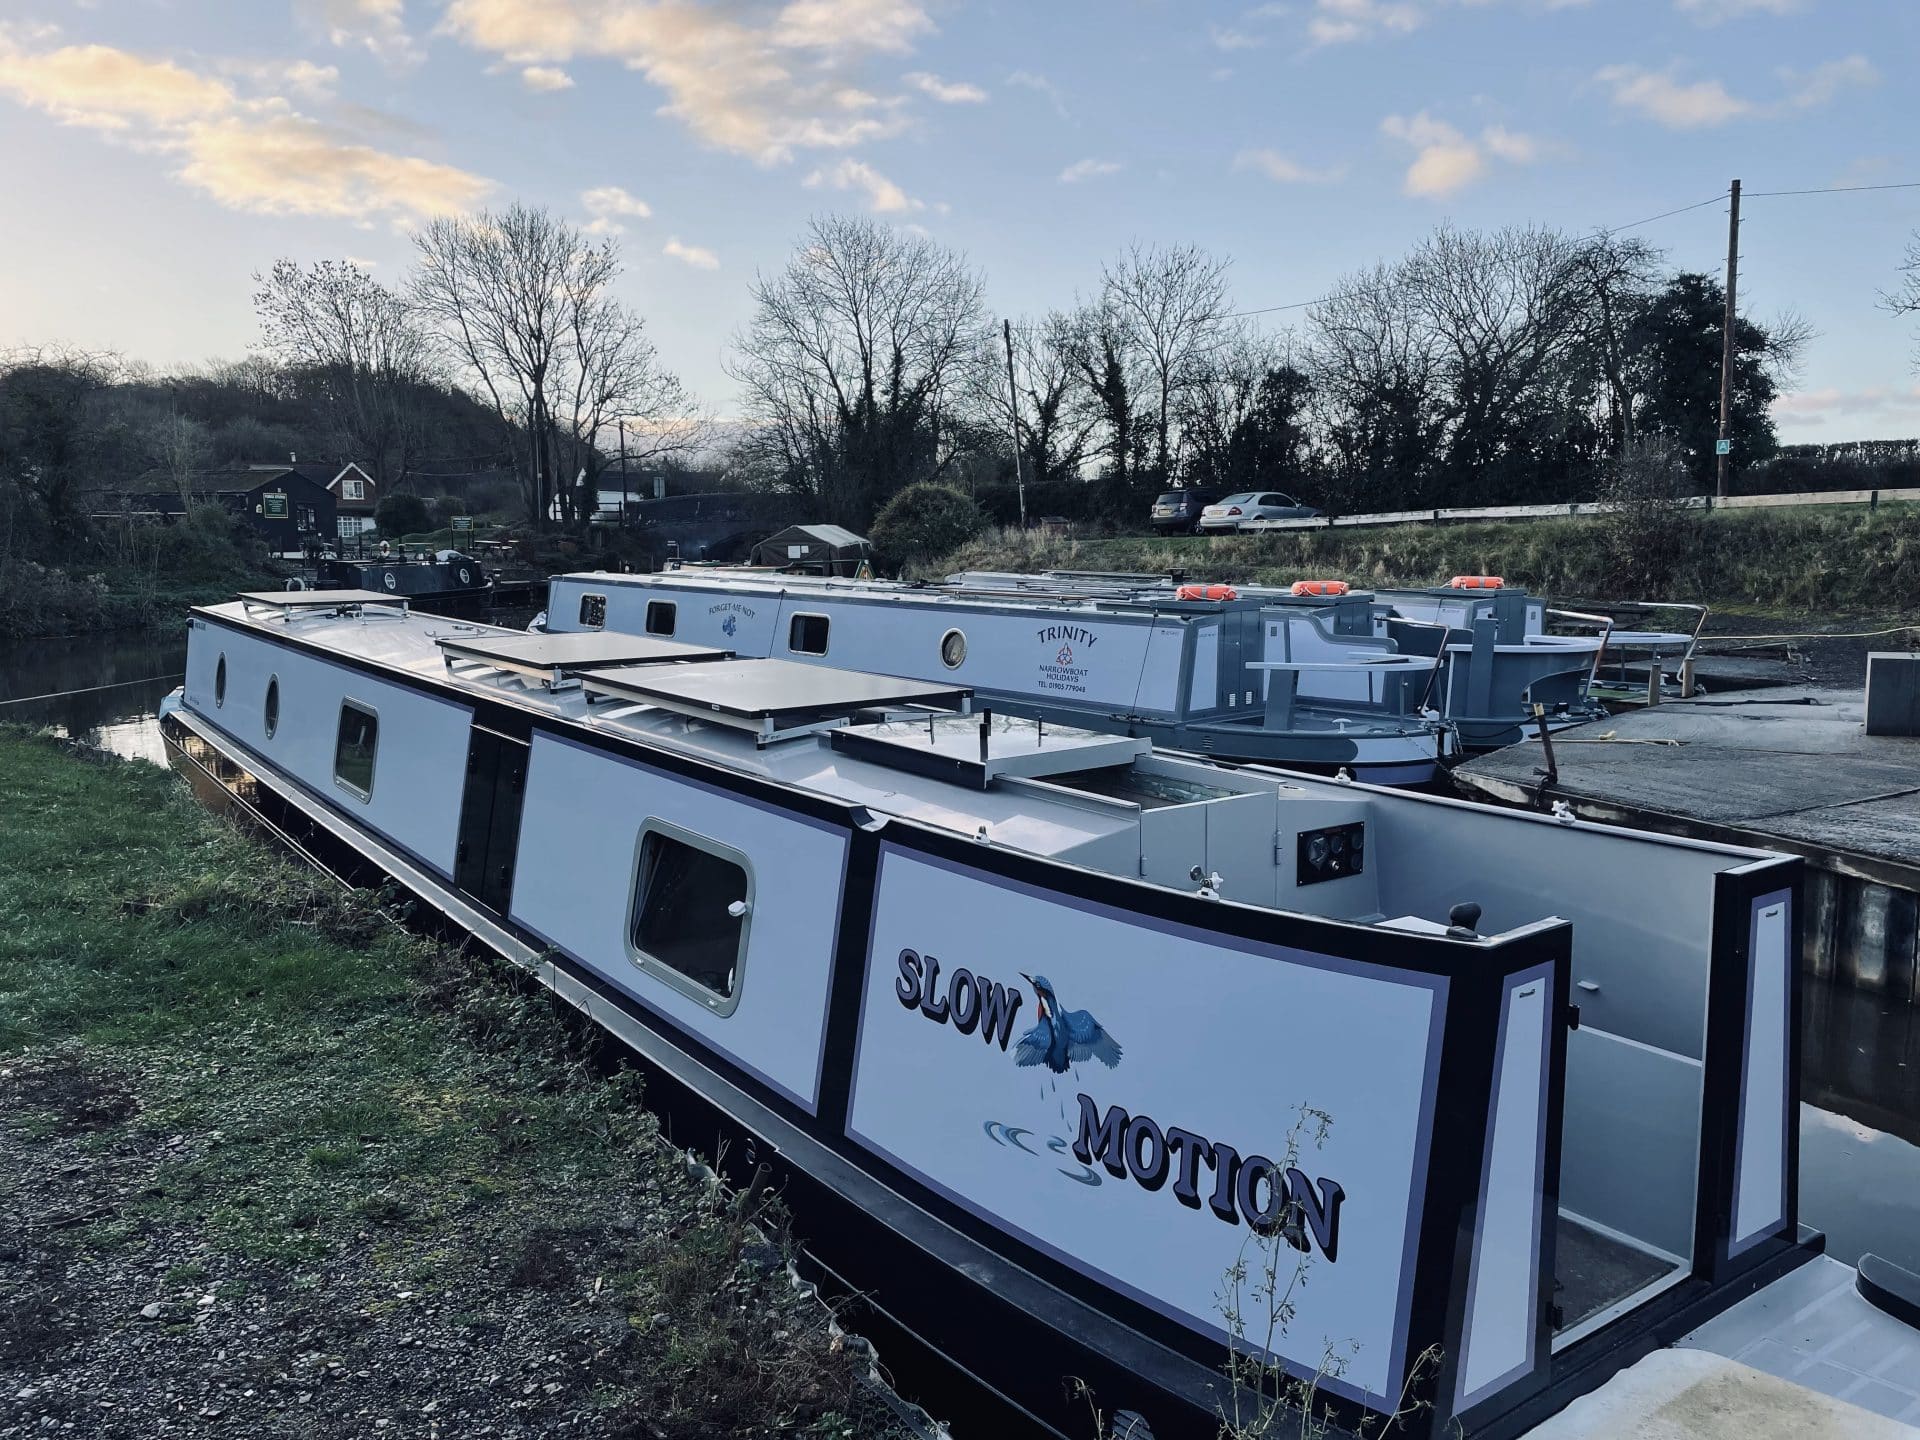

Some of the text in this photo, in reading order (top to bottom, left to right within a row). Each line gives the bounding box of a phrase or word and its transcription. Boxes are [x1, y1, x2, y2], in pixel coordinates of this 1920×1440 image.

[1037, 626, 1098, 648] TRINITY
[1039, 665, 1088, 676] NARROWBOAT
[1046, 673, 1079, 682] HOLIDAYS
[896, 949, 1023, 1052] SLOW
[1073, 1093, 1345, 1263] MOTION
